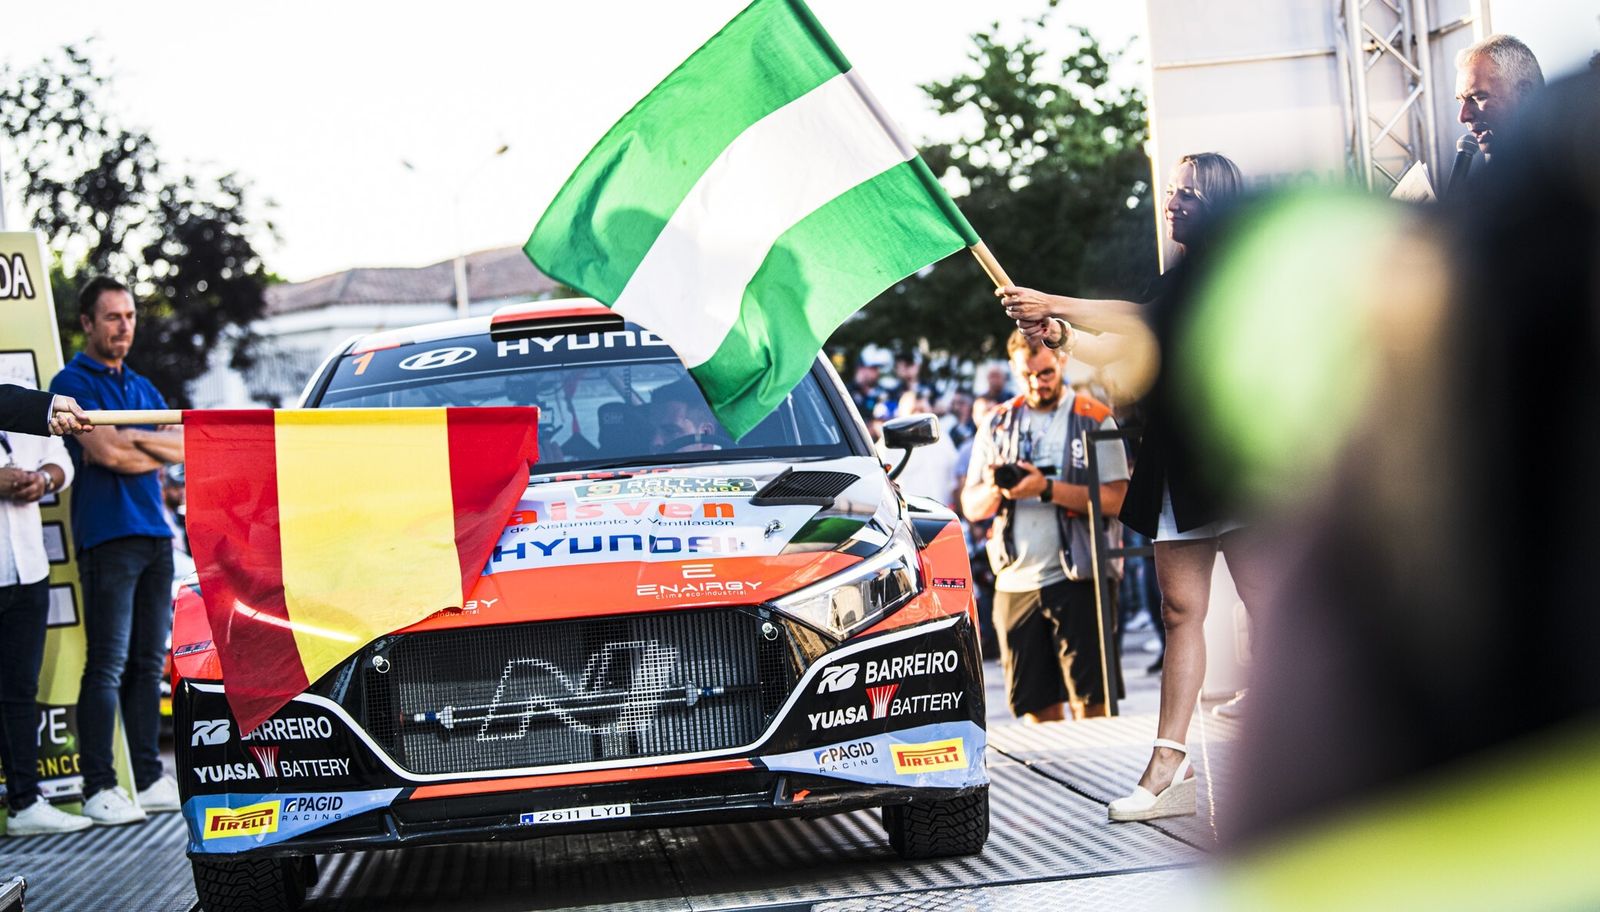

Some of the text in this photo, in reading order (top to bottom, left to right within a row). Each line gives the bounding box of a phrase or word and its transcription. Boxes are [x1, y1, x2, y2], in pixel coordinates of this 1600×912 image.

[0, 254, 34, 298] DA
[497, 331, 668, 357] HYUND
[352, 352, 375, 375] 1
[627, 478, 728, 489] RALLYE
[535, 518, 627, 531] Aislamiento
[648, 518, 734, 526] Ventilación
[493, 534, 738, 562] HYUNDAI
[865, 650, 958, 684] BARREIRO
[808, 691, 963, 731] YUASA BATTERY
[819, 758, 878, 773] RACING
[830, 741, 958, 766] PAGID PIRELLI
[193, 758, 350, 783] YUASA BATTERY
[298, 796, 343, 812] PAGID
[539, 806, 625, 822] 2611 LYD
[211, 809, 273, 831] PIRELLI
